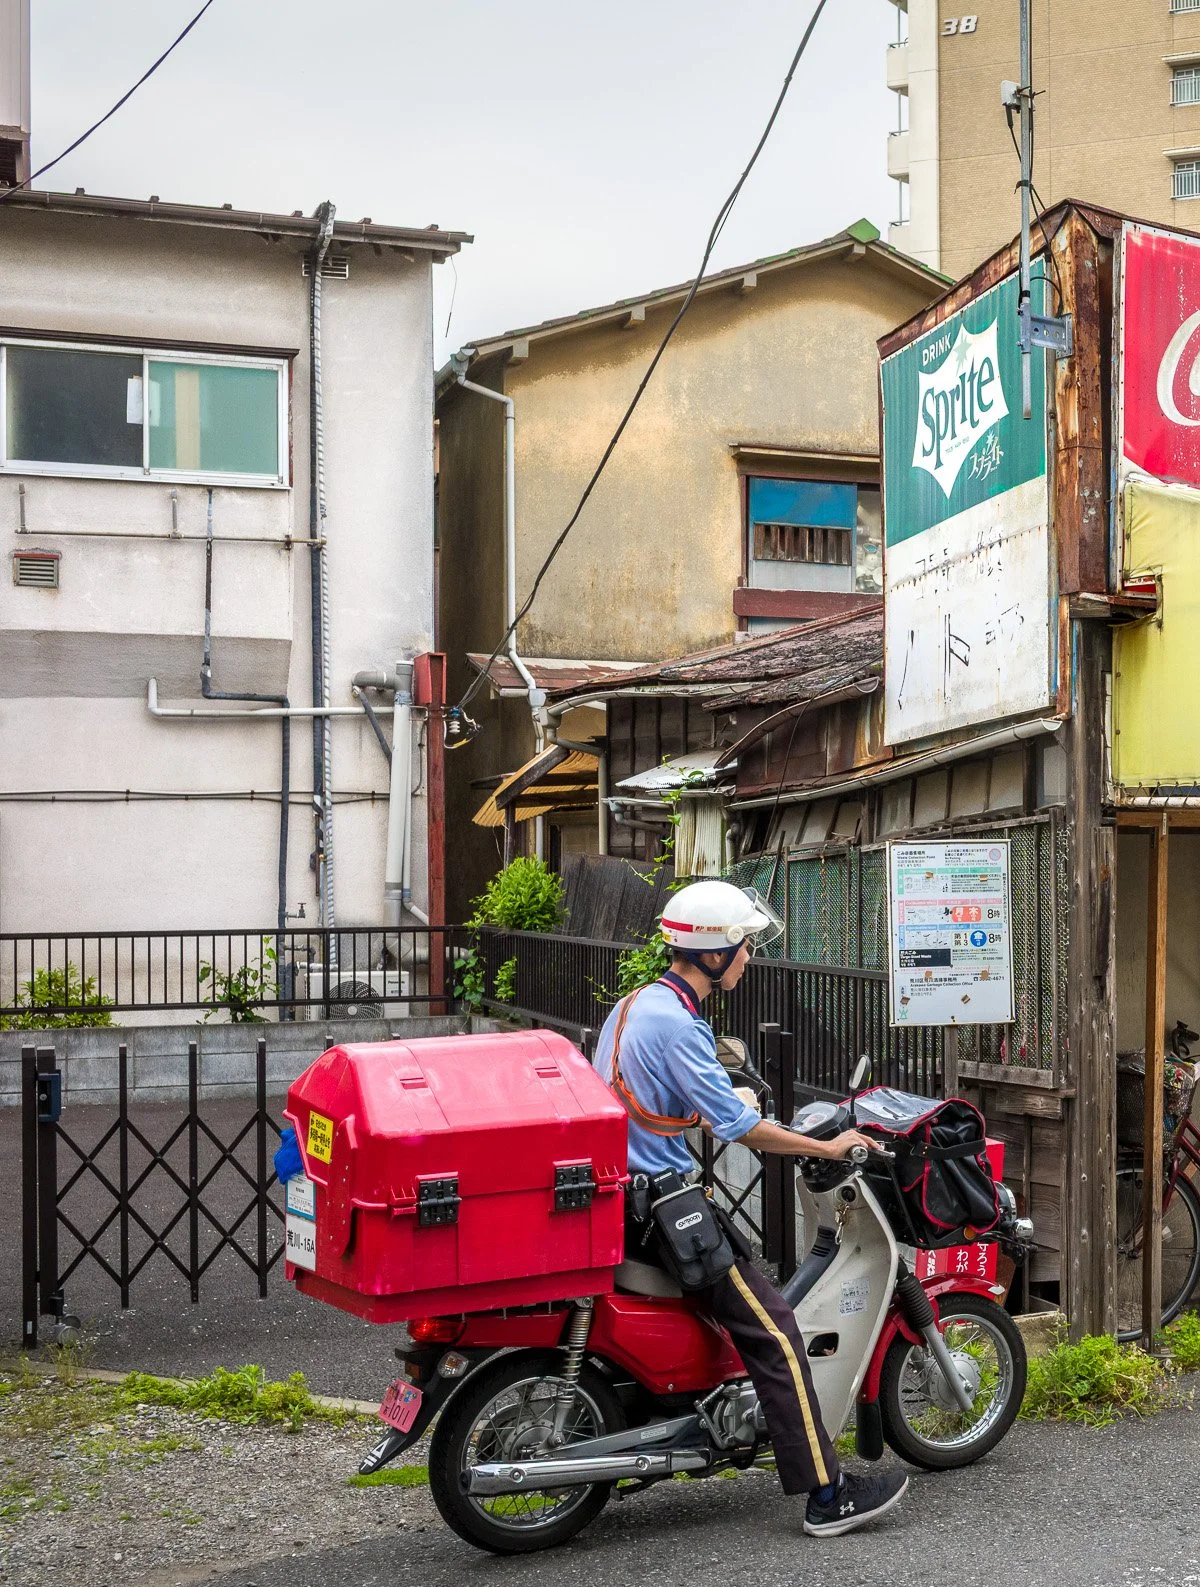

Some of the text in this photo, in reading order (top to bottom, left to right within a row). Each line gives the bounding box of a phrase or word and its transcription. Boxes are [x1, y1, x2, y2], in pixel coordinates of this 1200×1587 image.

[941, 15, 978, 36] 38
[922, 333, 952, 366] DRINK
[922, 356, 995, 470] Sprite
[955, 907, 964, 915] 月
[388, 1402, 411, 1426] 1011
